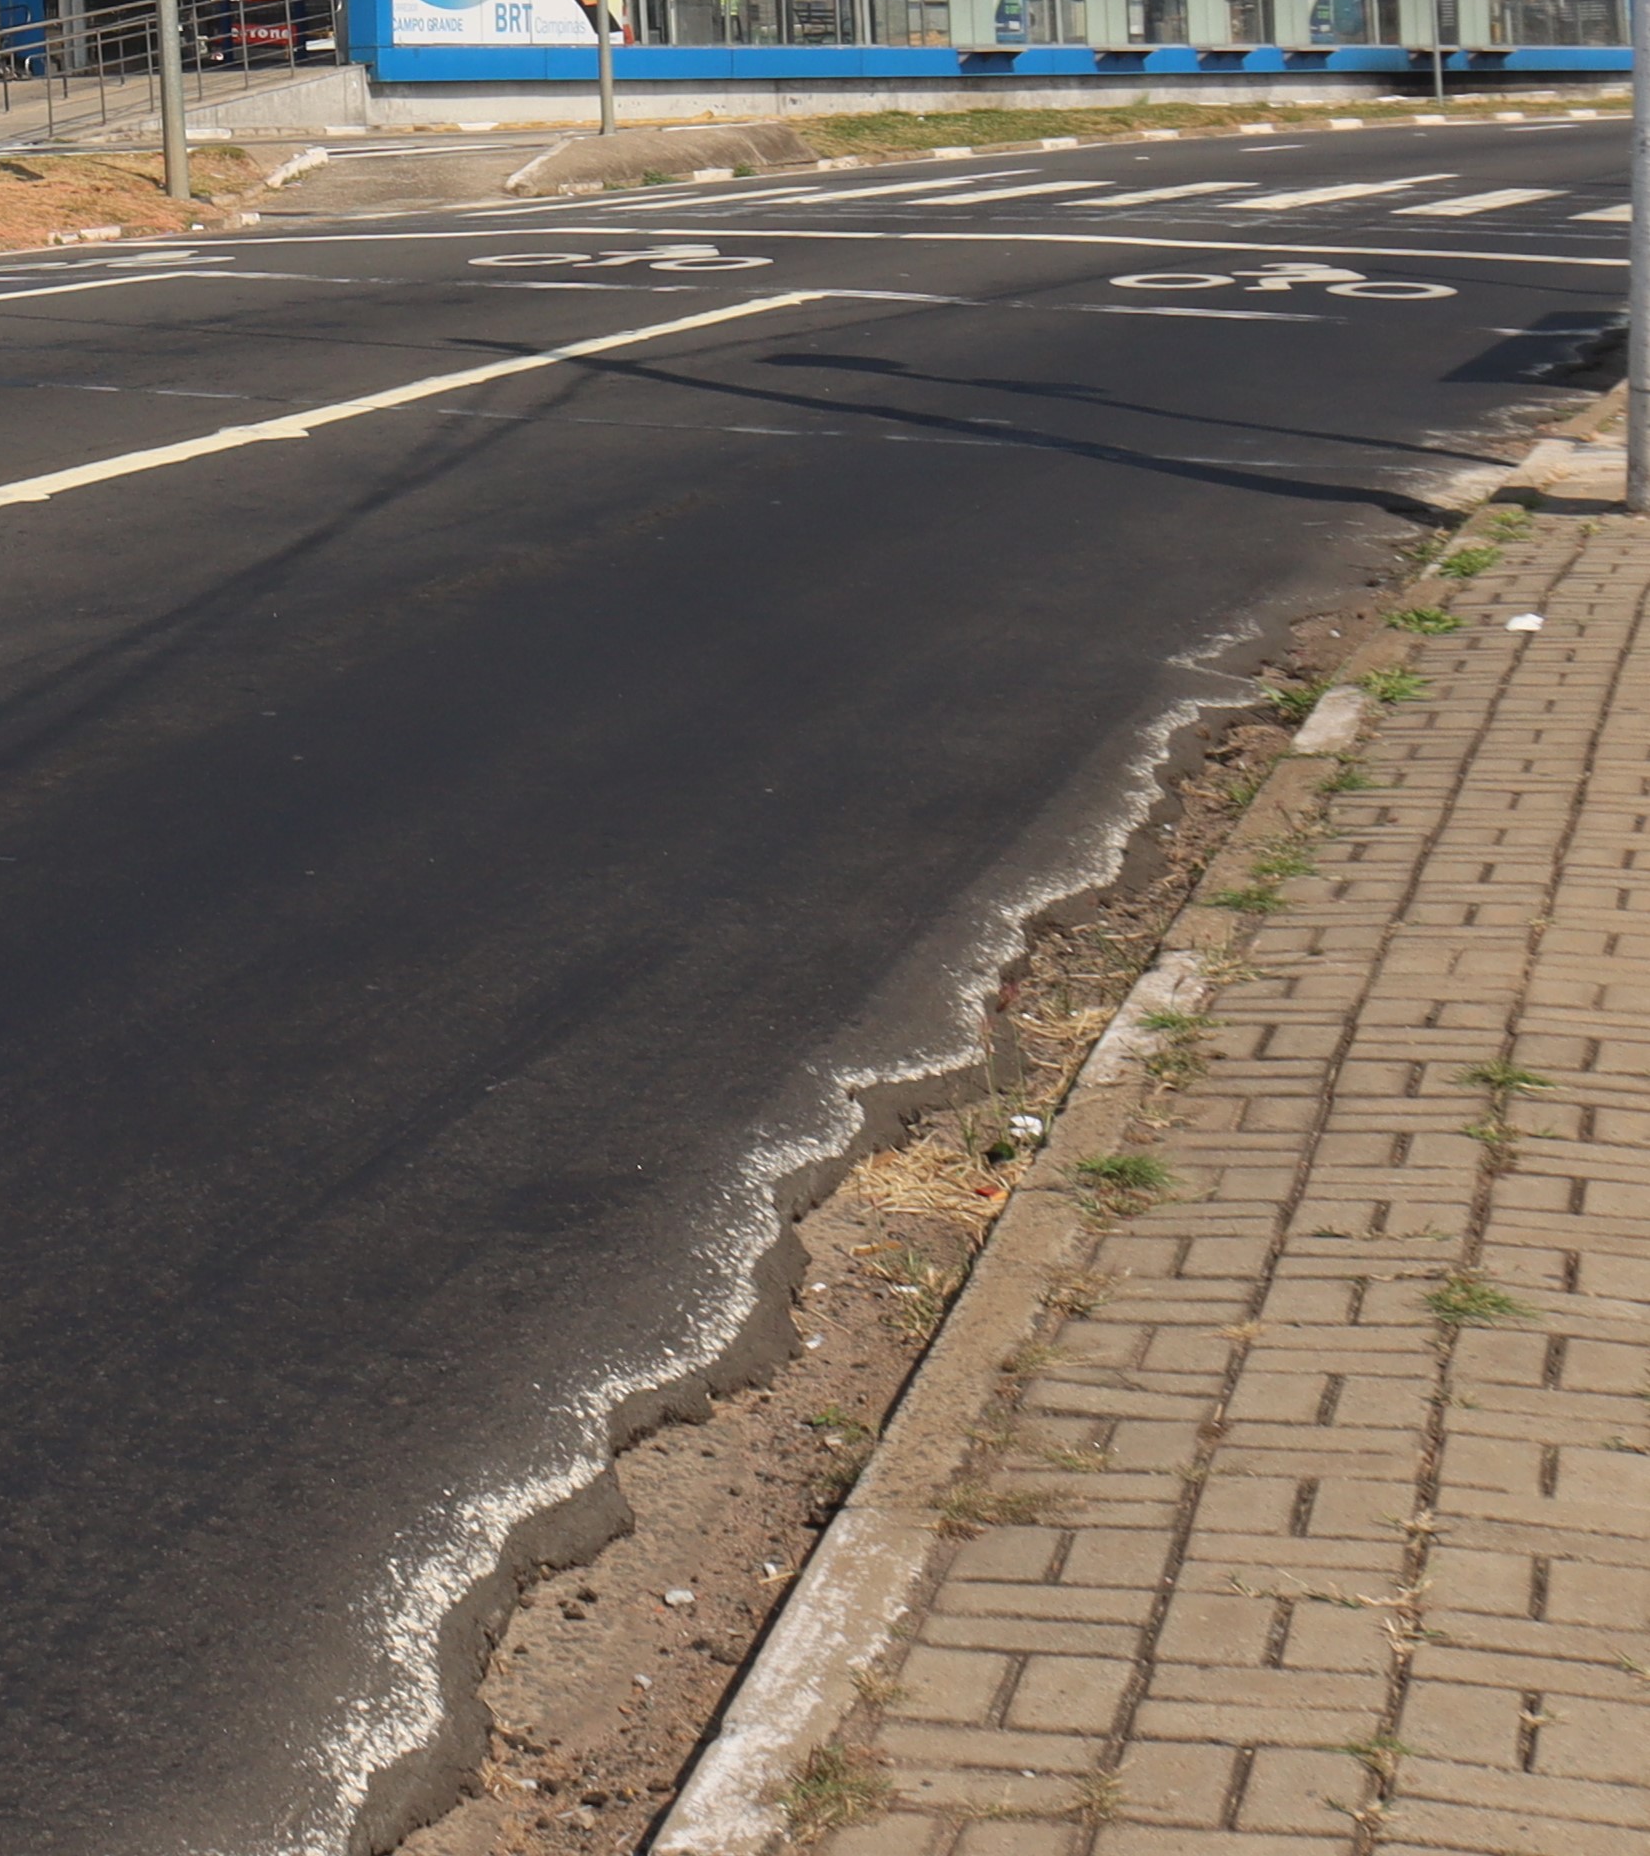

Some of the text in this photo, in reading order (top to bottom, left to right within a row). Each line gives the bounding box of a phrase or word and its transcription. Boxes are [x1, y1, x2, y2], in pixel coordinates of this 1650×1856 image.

[427, 17, 464, 32] GRANDE
[495, 2, 586, 35] BRT Campinas
